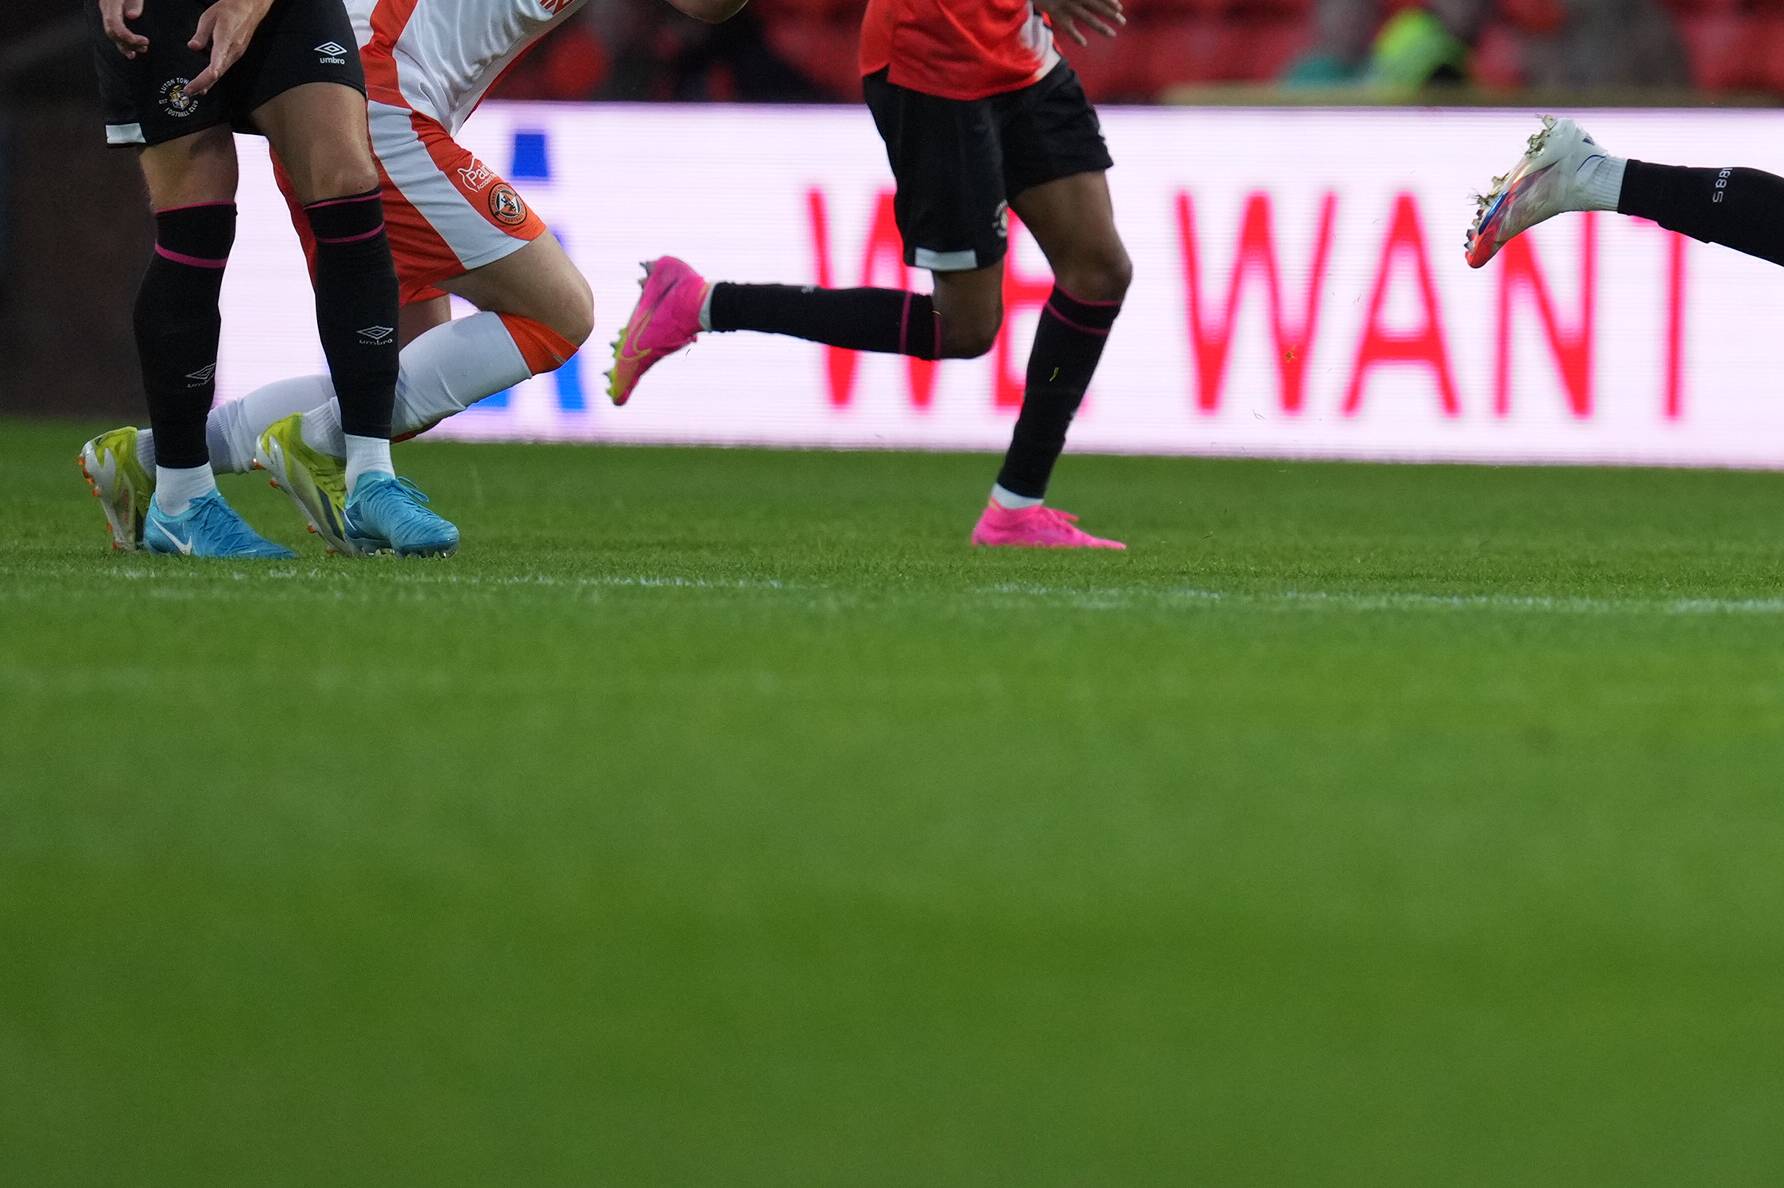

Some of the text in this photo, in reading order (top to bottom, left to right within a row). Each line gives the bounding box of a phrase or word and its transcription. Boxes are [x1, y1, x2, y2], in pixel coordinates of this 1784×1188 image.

[319, 56, 346, 65] umbro
[175, 77, 189, 85] TOW
[1712, 167, 1733, 203] 1885
[1174, 188, 1692, 424] WANT
